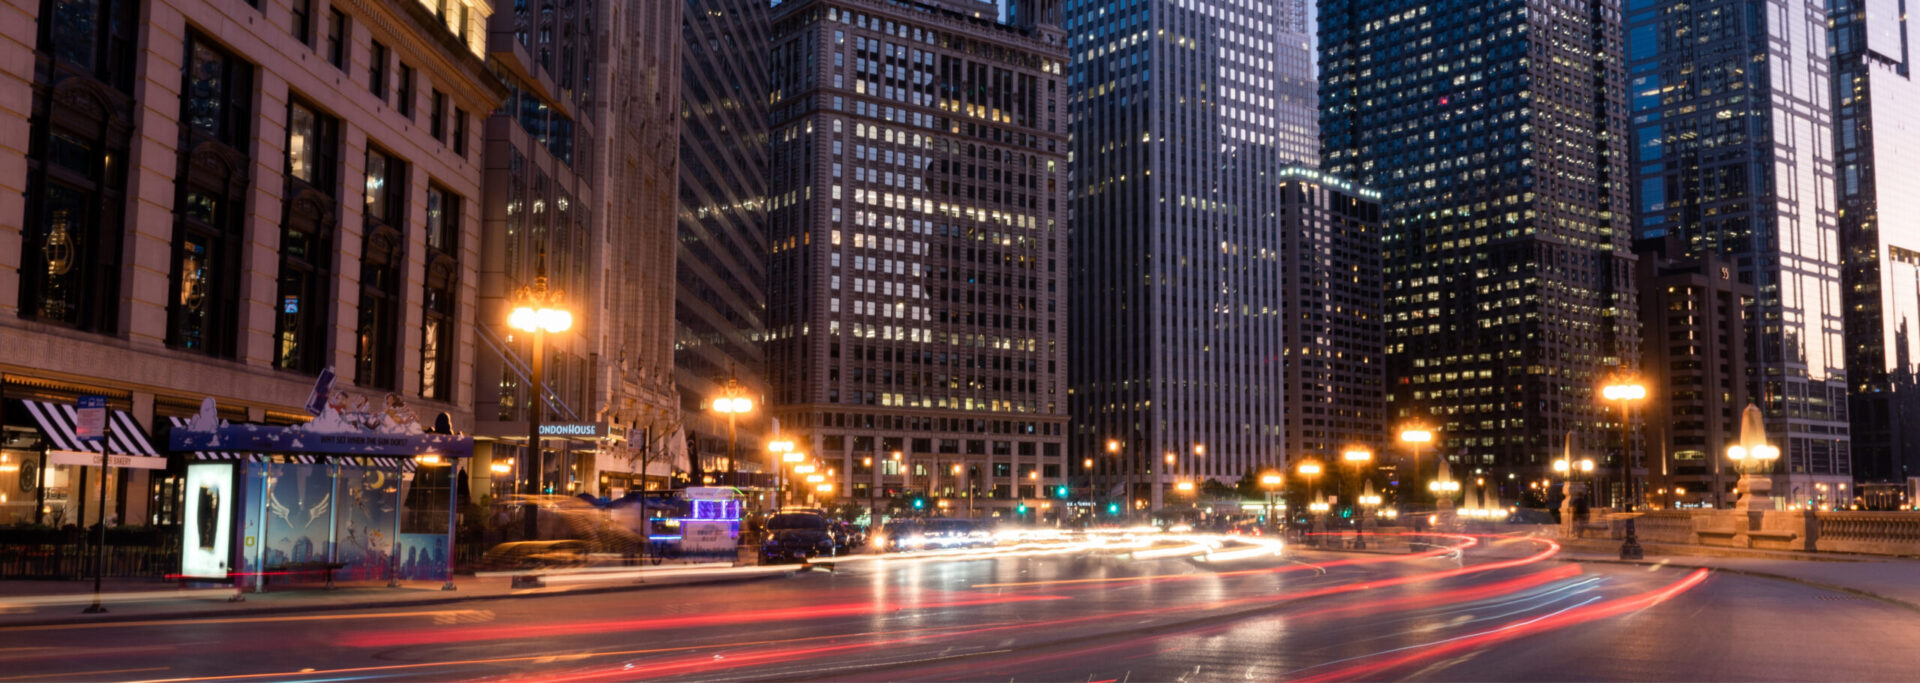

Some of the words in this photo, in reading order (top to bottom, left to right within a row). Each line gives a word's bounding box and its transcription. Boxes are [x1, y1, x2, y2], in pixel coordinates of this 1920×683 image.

[539, 424, 596, 435] ONDONHOUSE
[320, 435, 335, 443] WHY
[336, 436, 346, 444] SET
[347, 436, 366, 445] WHEN
[367, 437, 377, 445] THE
[93, 455, 112, 464] CORR
[113, 456, 132, 465] BAKERY
